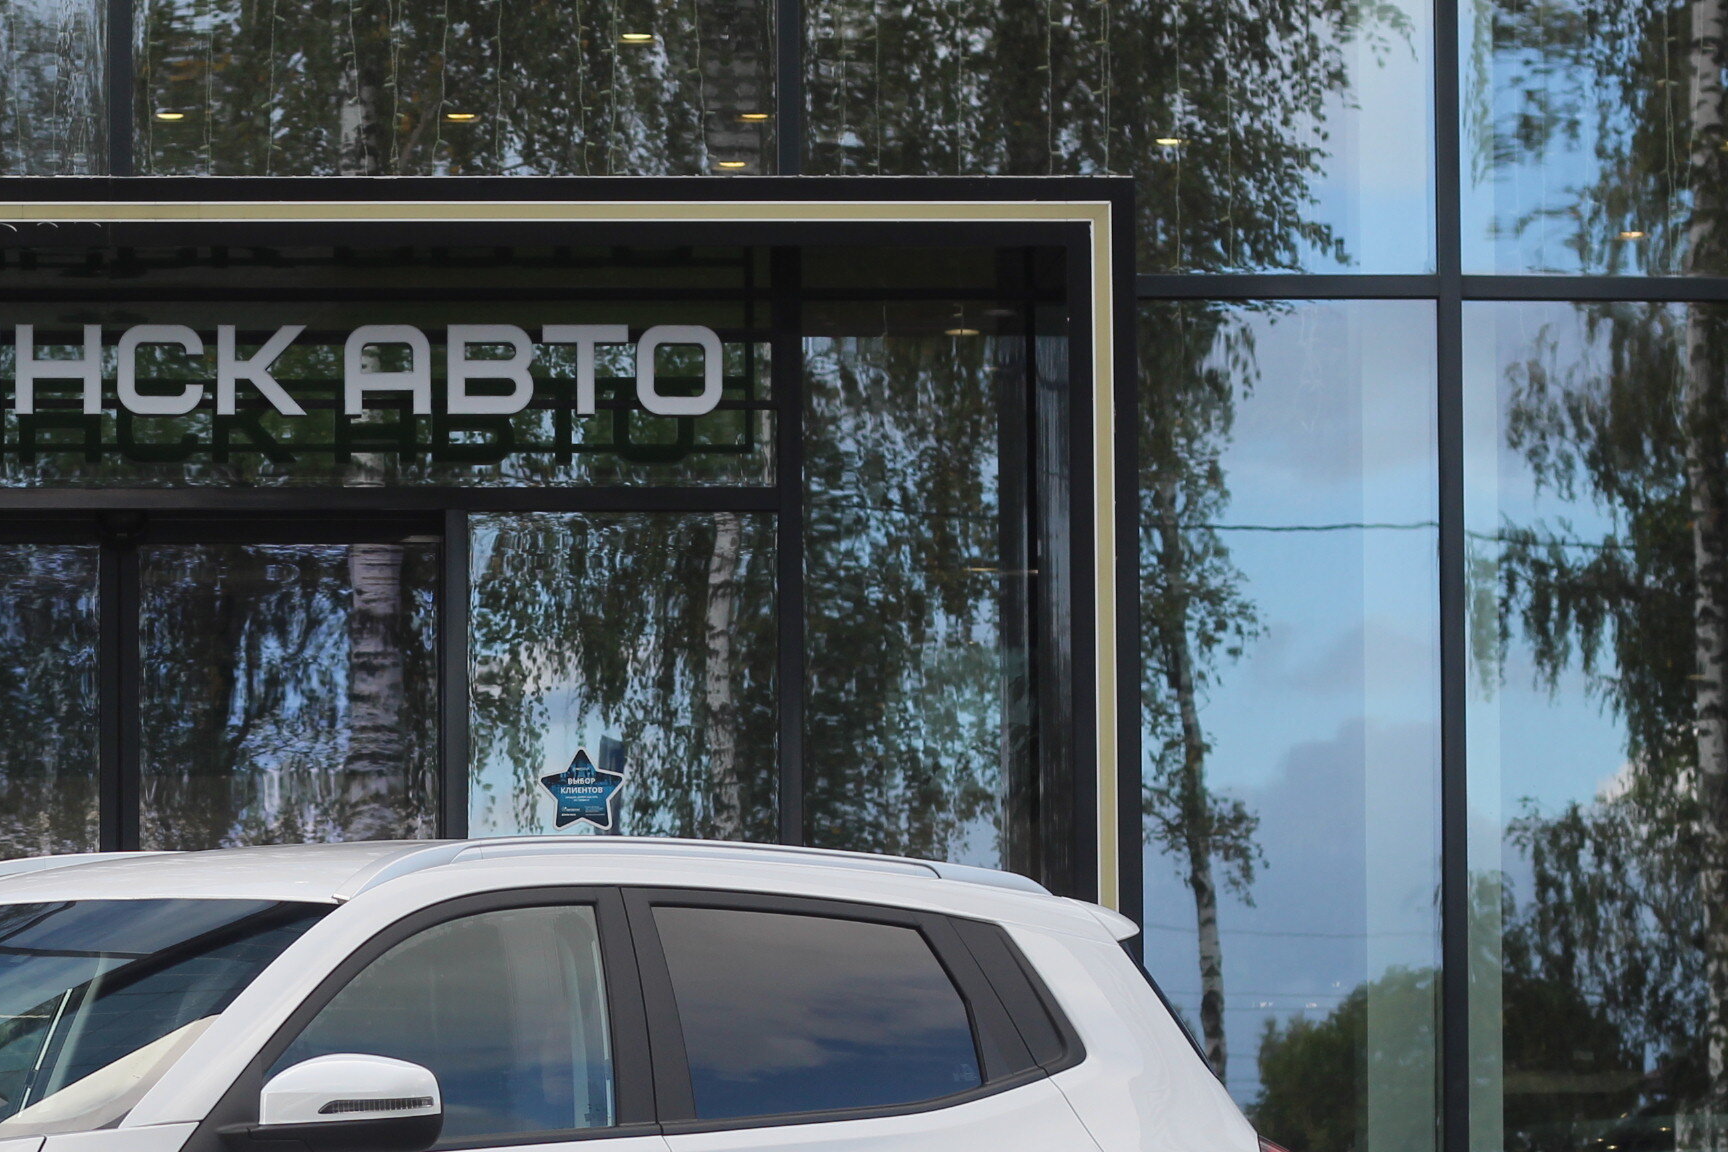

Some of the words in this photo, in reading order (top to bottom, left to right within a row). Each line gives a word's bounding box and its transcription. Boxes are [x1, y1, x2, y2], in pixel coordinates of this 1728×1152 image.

[342, 322, 724, 416] АВТО
[567, 777, 596, 785] ВЫБОР
[560, 786, 603, 794] КЛИЕНТОВ
